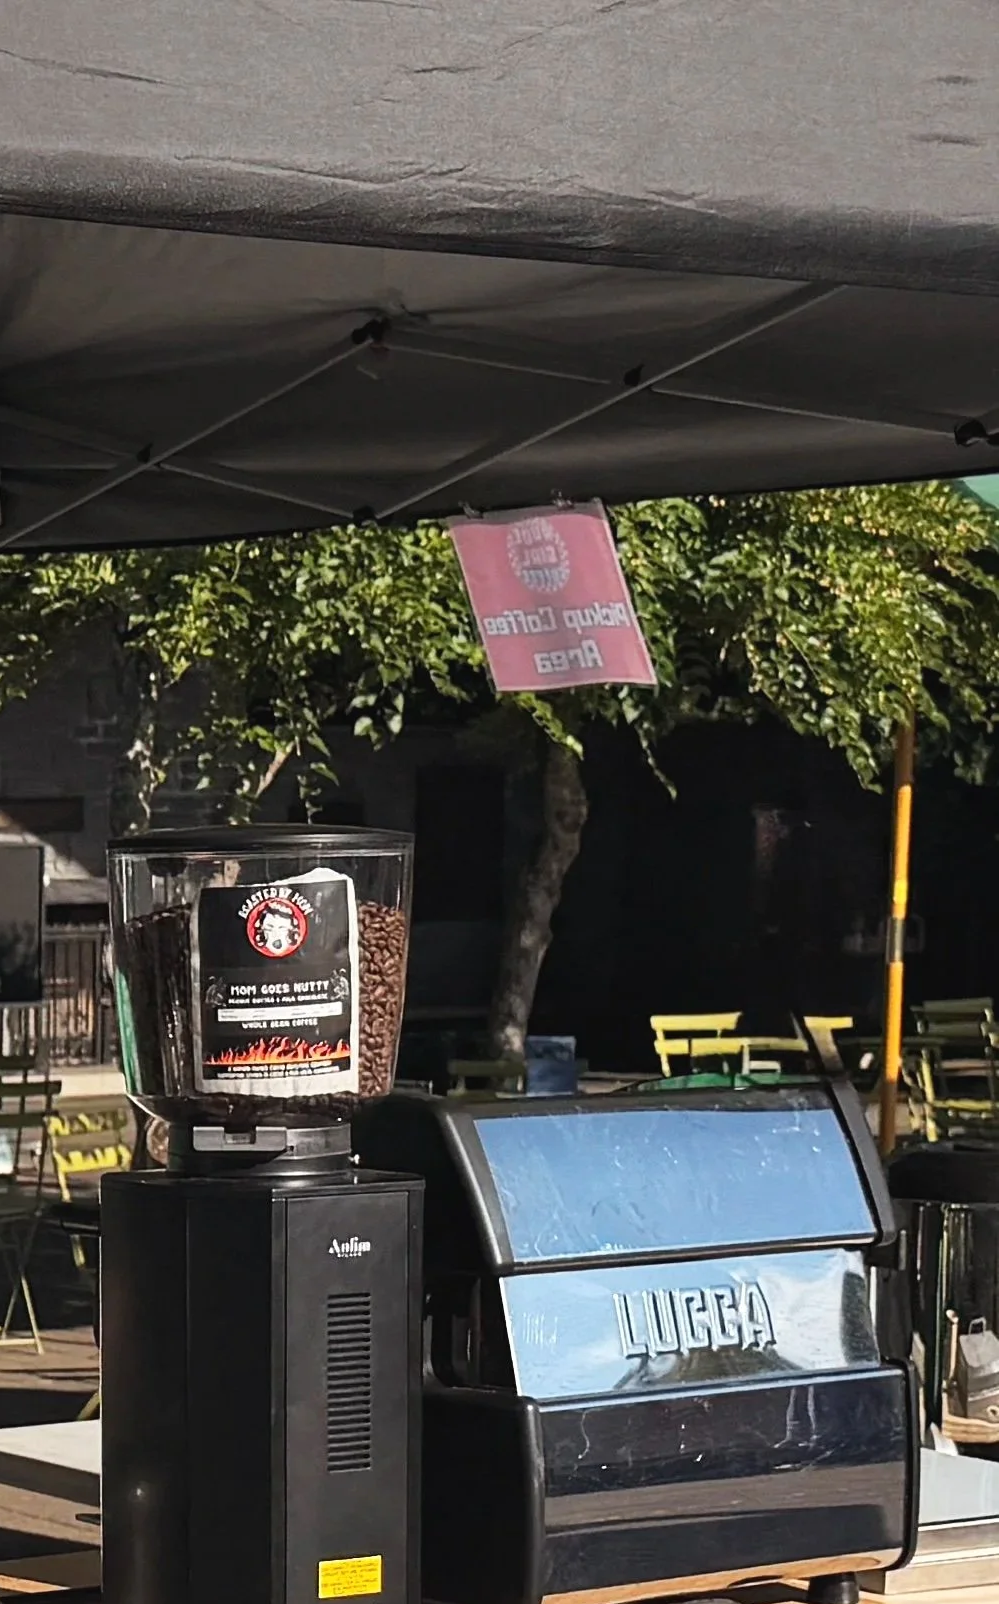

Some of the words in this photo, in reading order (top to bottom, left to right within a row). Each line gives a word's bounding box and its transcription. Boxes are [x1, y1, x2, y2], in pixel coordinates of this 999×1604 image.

[231, 985, 257, 996] MOM
[293, 980, 330, 993] NUTTY
[242, 1021, 267, 1029] WHOLE
[270, 1020, 290, 1028] BEAN
[292, 1018, 318, 1027] COFFEE
[612, 1280, 778, 1358] LUCCA
